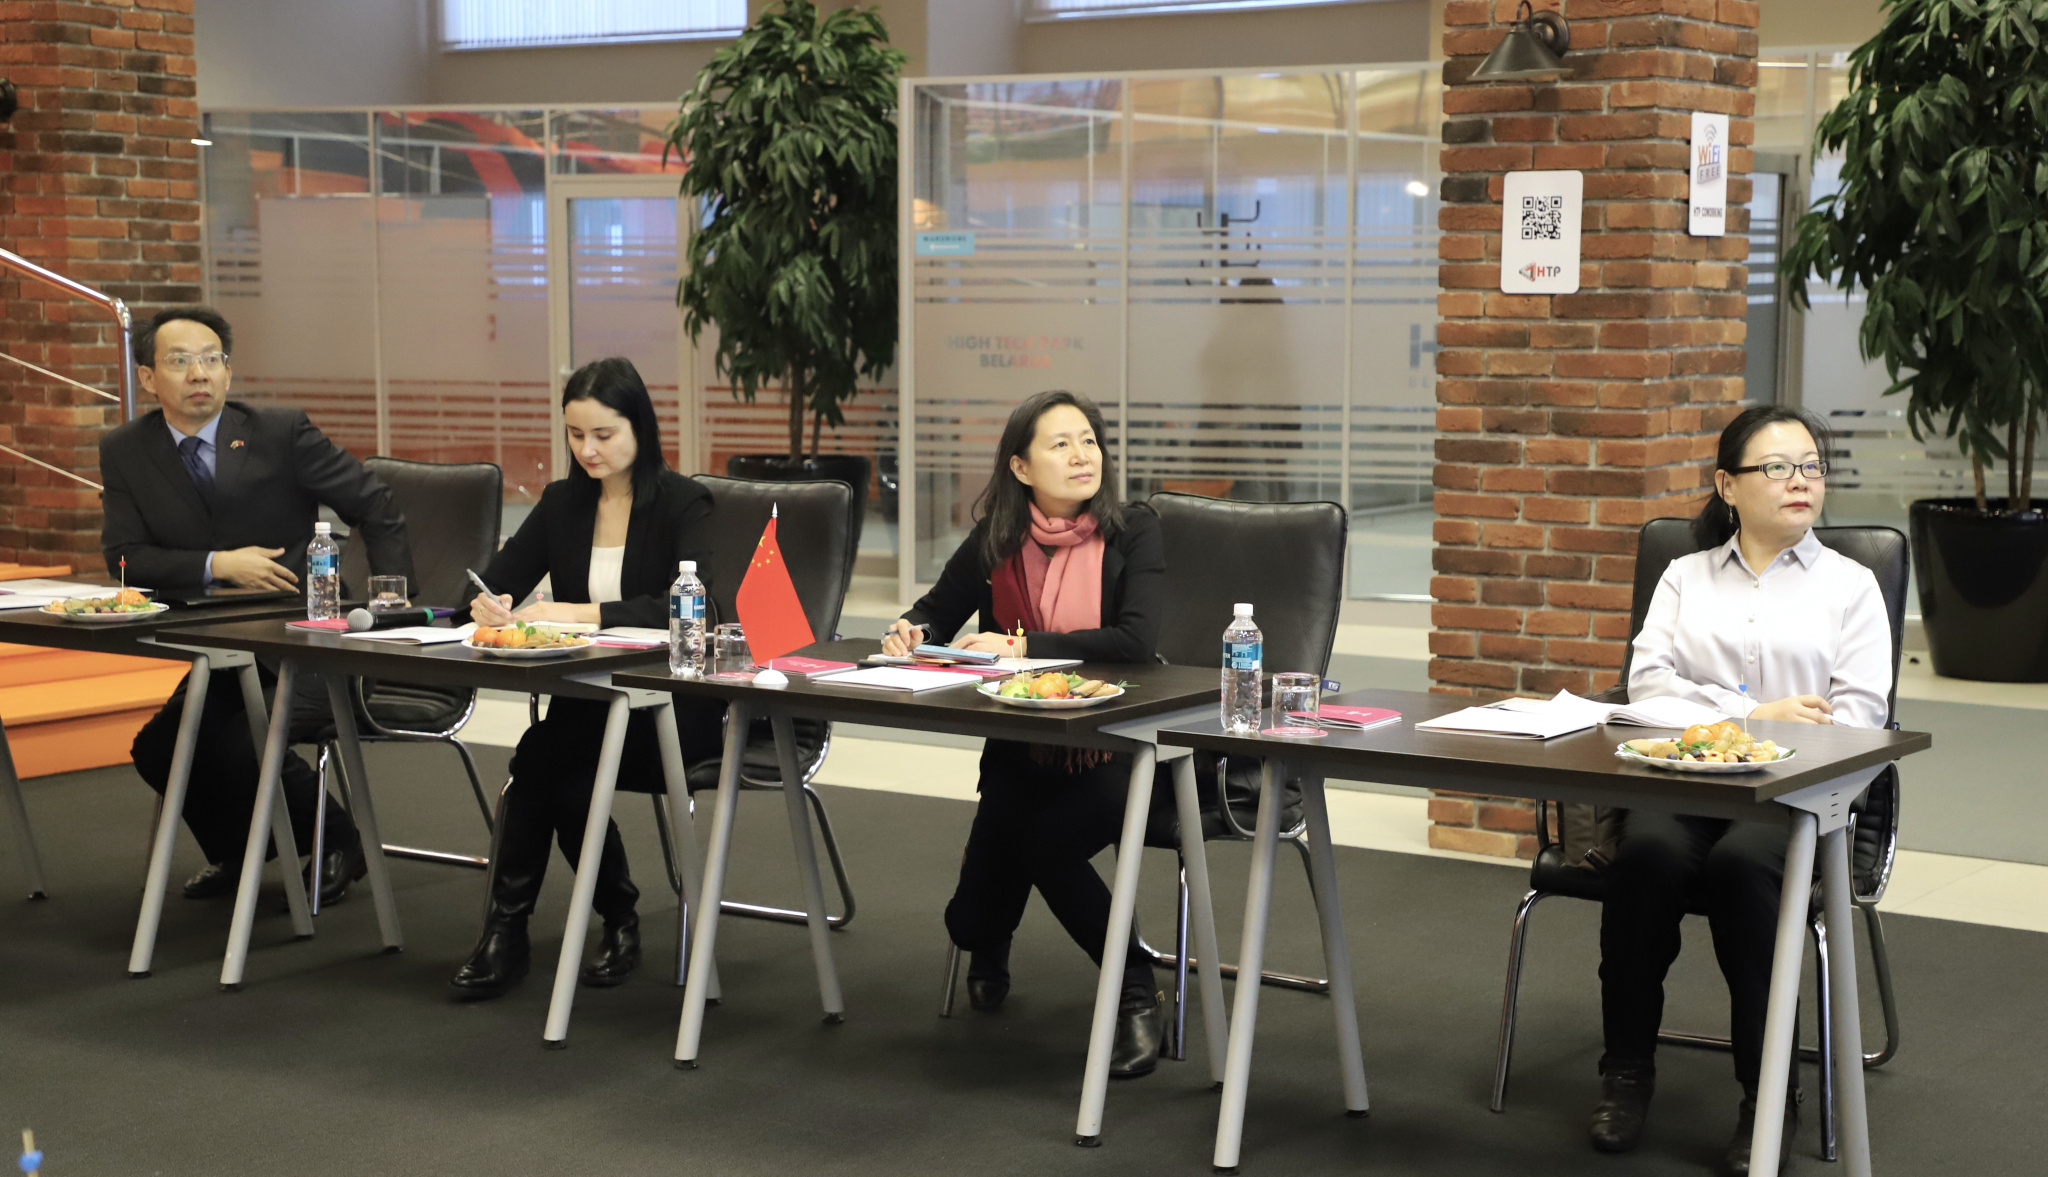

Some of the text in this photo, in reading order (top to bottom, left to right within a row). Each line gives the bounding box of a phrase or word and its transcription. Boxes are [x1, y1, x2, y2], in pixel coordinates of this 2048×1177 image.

[1700, 166, 1720, 180] FREE
[1536, 265, 1561, 278] HTP
[947, 334, 1084, 350] HIGH TECH PARK
[980, 353, 1051, 369] BELARUS
